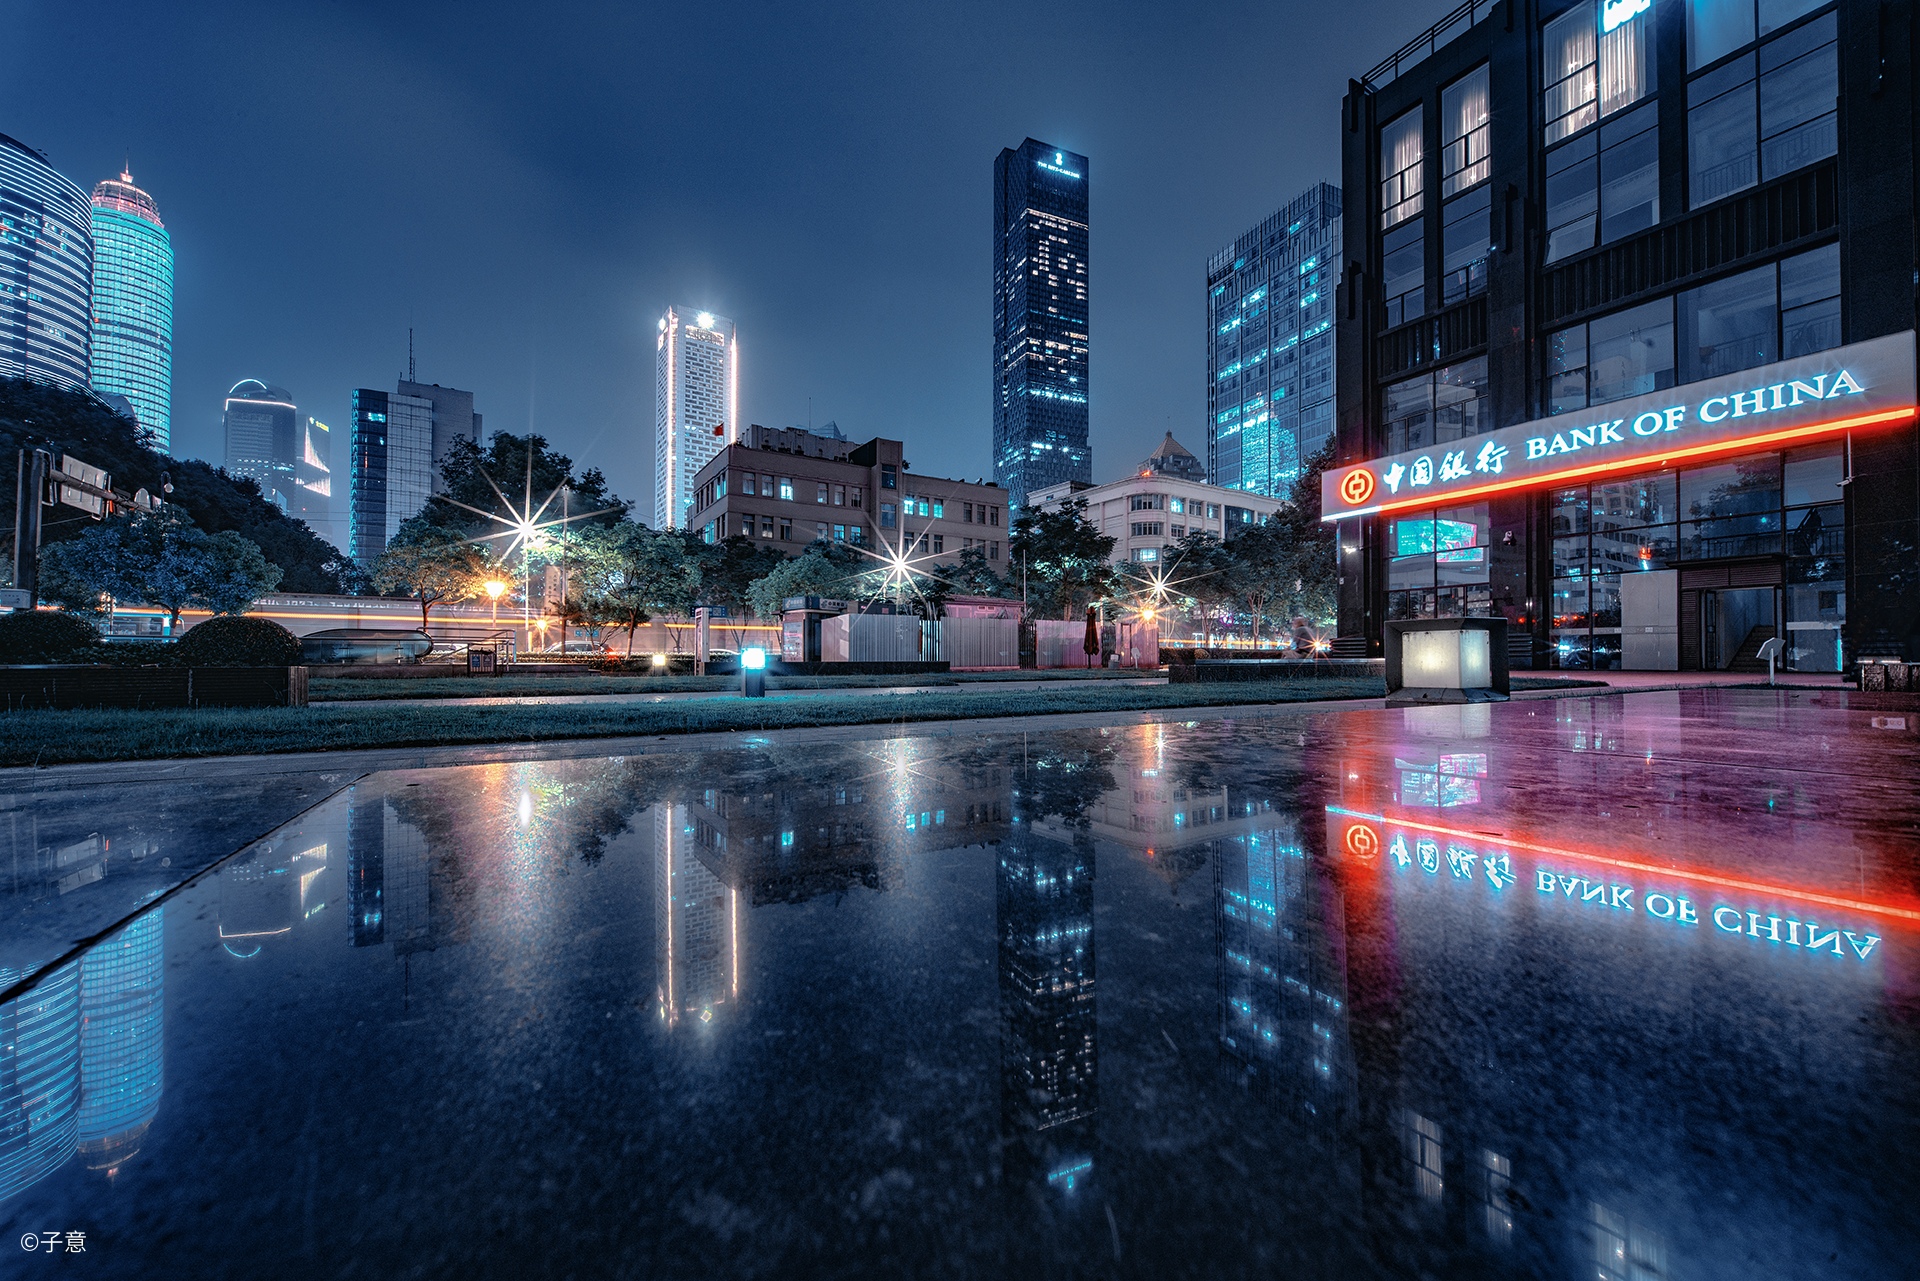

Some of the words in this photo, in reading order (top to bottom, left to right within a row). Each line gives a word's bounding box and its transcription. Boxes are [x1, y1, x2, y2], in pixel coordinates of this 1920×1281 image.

[1526, 420, 1625, 460] BANK
[1633, 405, 1686, 437] OF
[1699, 369, 1865, 423] CHINA
